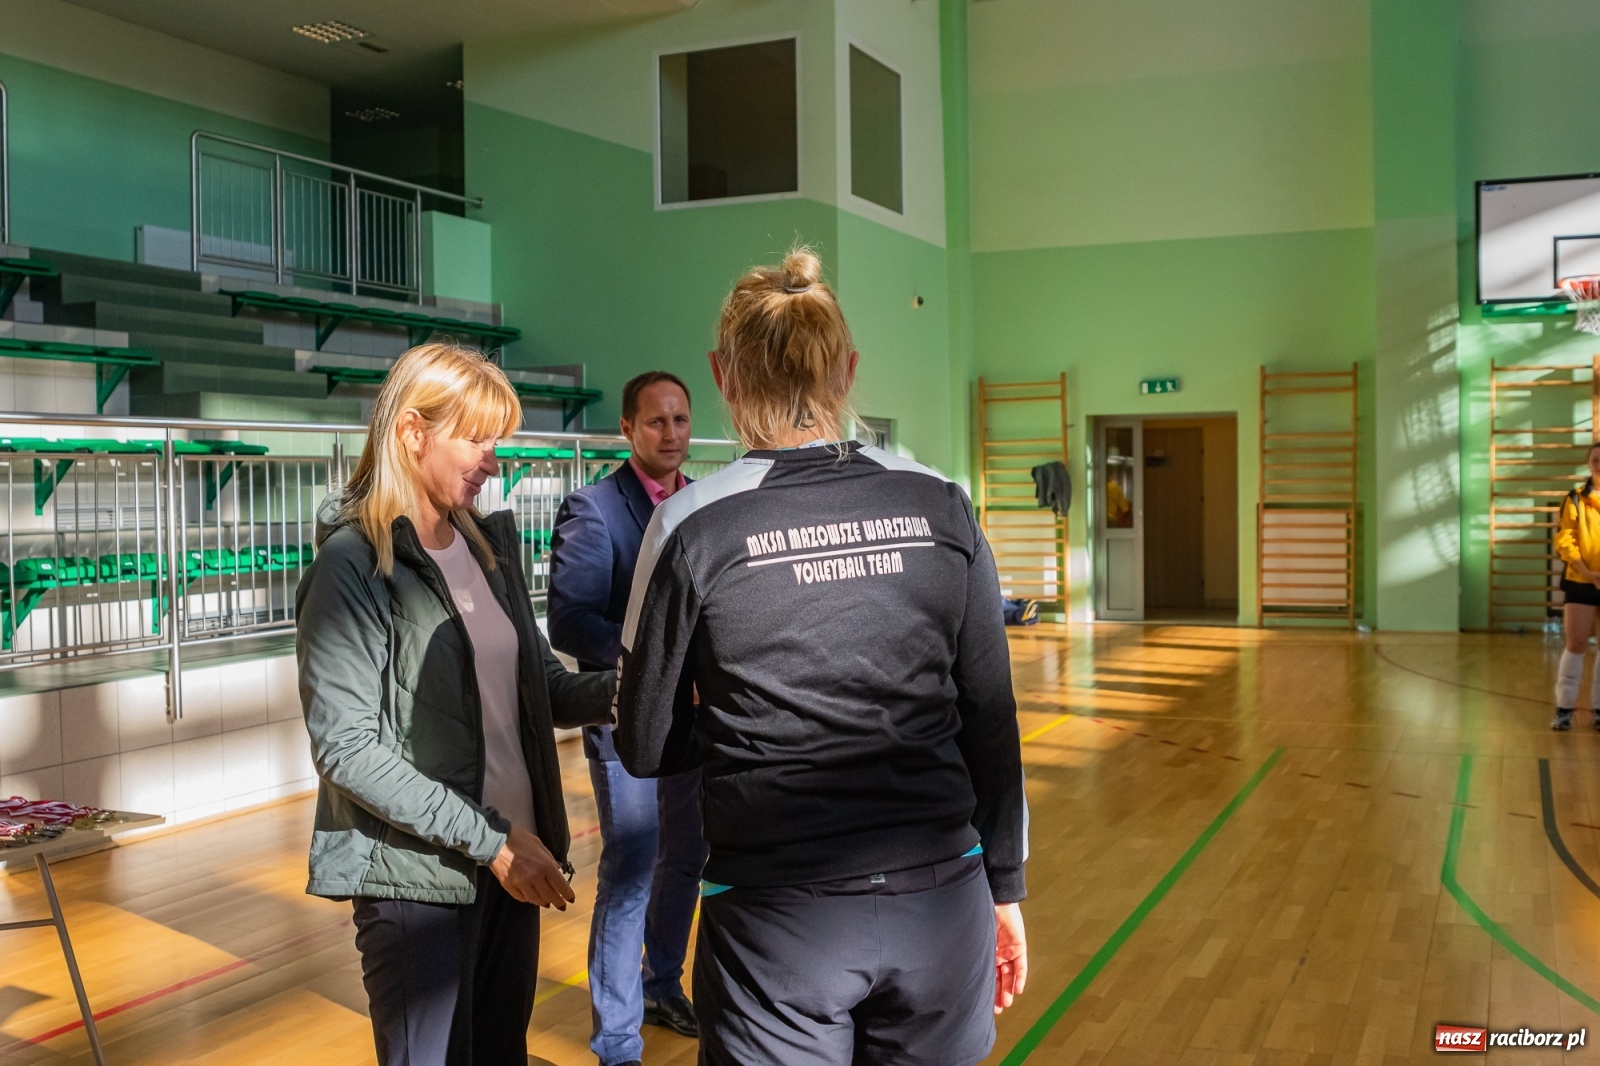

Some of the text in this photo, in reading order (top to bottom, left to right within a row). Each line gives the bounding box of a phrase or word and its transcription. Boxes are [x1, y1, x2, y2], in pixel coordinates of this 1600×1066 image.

[746, 516, 932, 557] MKSN MAZOWSZE WARSZAWA
[793, 551, 904, 585] VOLLEYBALL TEAM
